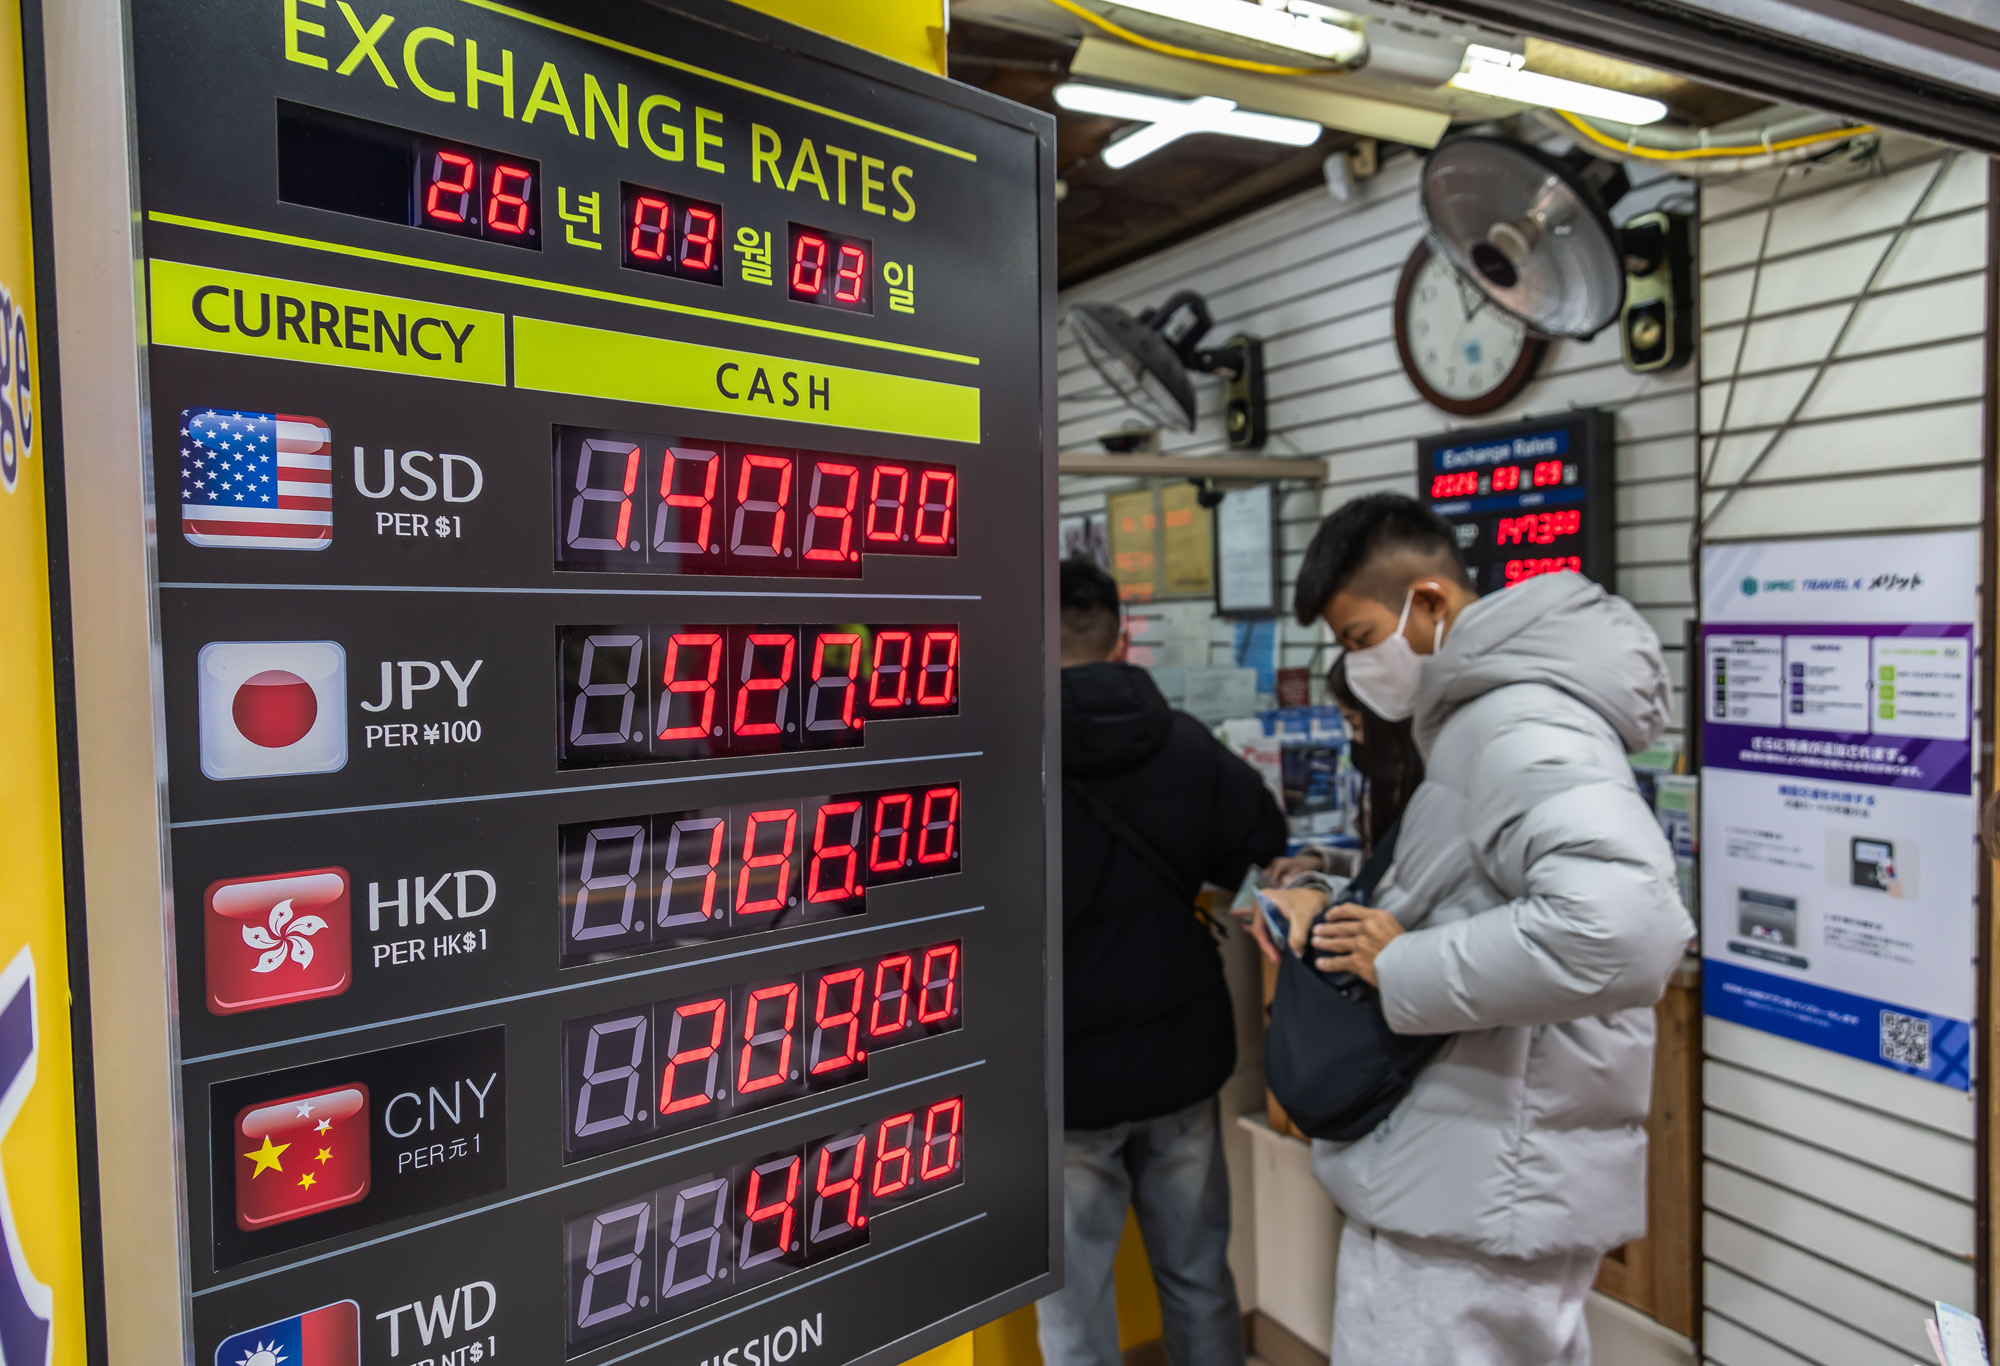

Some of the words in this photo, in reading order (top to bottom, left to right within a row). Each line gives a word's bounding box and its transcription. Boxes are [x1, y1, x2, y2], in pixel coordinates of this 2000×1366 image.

[283, 0, 725, 174] EXCHANGE
[751, 122, 917, 223] RATES
[426, 151, 531, 234] 26
[558, 186, 603, 251] 년
[630, 196, 717, 270] 03
[733, 226, 773, 286] 월
[792, 235, 866, 303] 03
[883, 261, 915, 315] 일
[191, 285, 475, 365] CURRENCY
[715, 361, 832, 412] CASH
[353, 446, 484, 503] USD
[376, 511, 429, 537] PER
[434, 515, 461, 539] $1
[360, 659, 484, 712] JPY
[364, 723, 418, 748] PER
[423, 719, 482, 744] ¥100
[368, 869, 497, 932] HKD
[372, 938, 426, 968] PER
[433, 928, 488, 959] HK$1
[384, 1072, 497, 1138] CNY
[398, 1143, 444, 1174] PER
[375, 1280, 497, 1358] TWD
